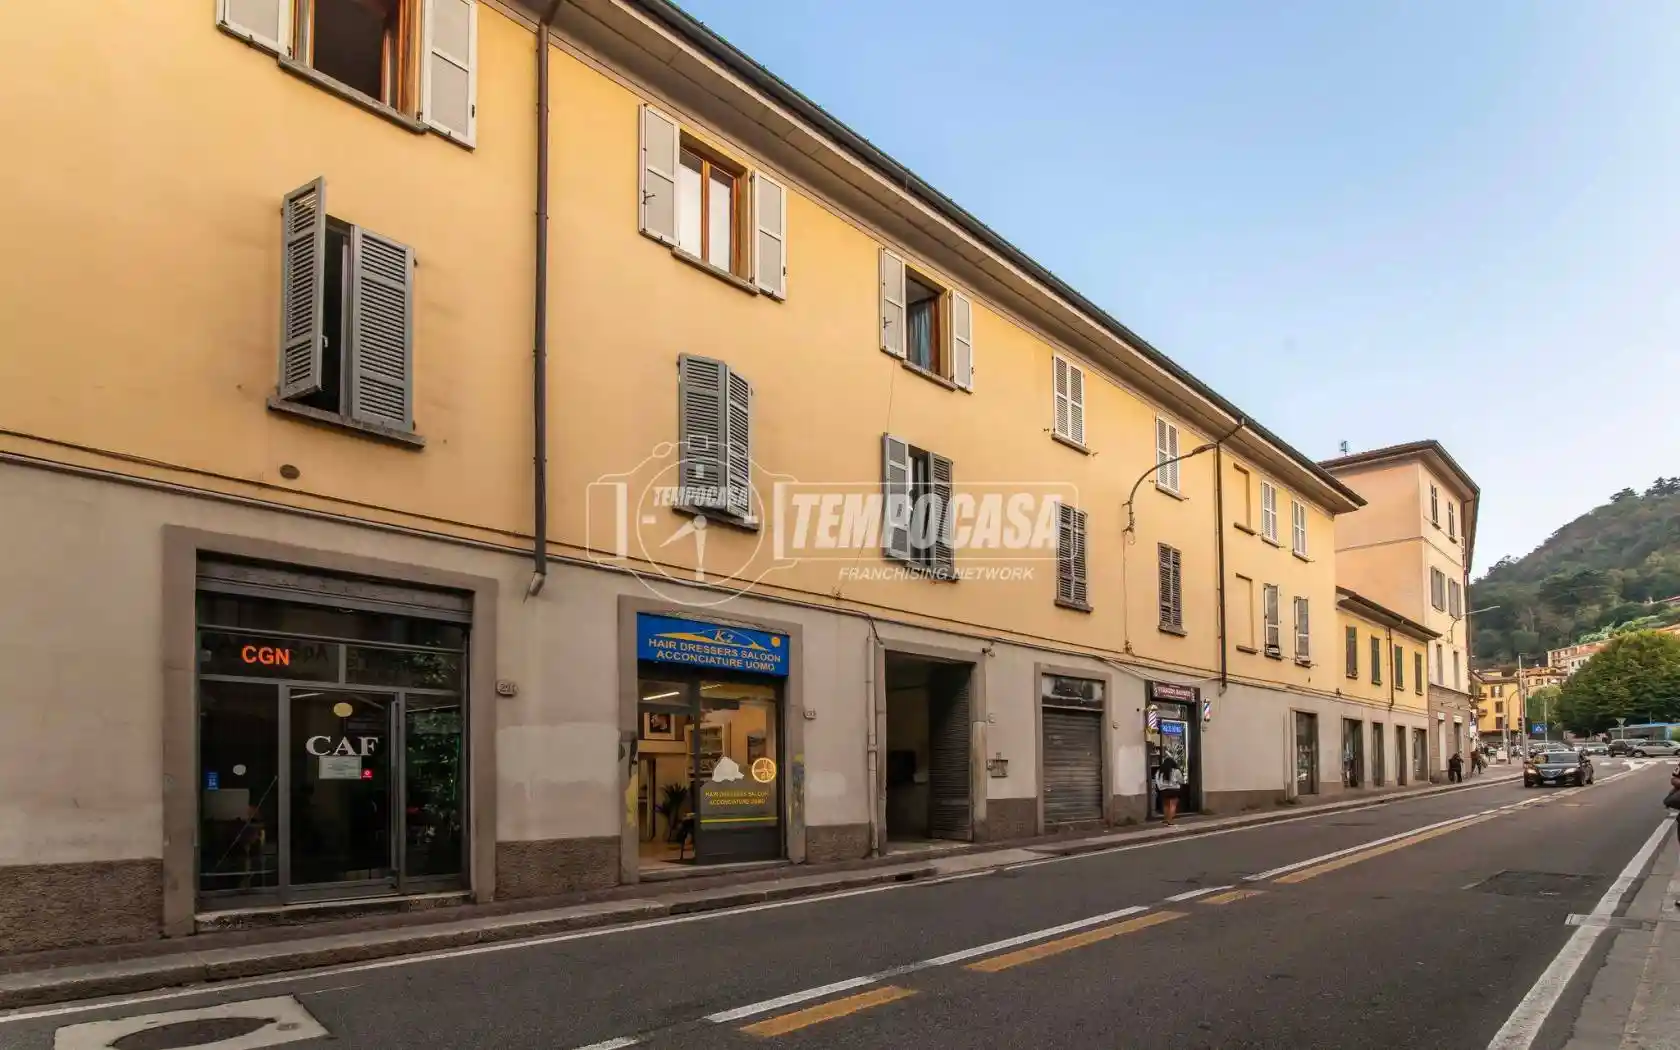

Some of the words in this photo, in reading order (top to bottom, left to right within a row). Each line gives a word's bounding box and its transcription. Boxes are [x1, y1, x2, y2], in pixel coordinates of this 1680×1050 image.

[241, 644, 290, 666] CGN
[648, 638, 677, 650] HAIR
[680, 642, 738, 657] DRESSERS
[741, 650, 781, 663] SALOON
[656, 650, 743, 668] ACCONCIATURE
[746, 661, 776, 672] UOMO
[305, 735, 379, 756] CAF
